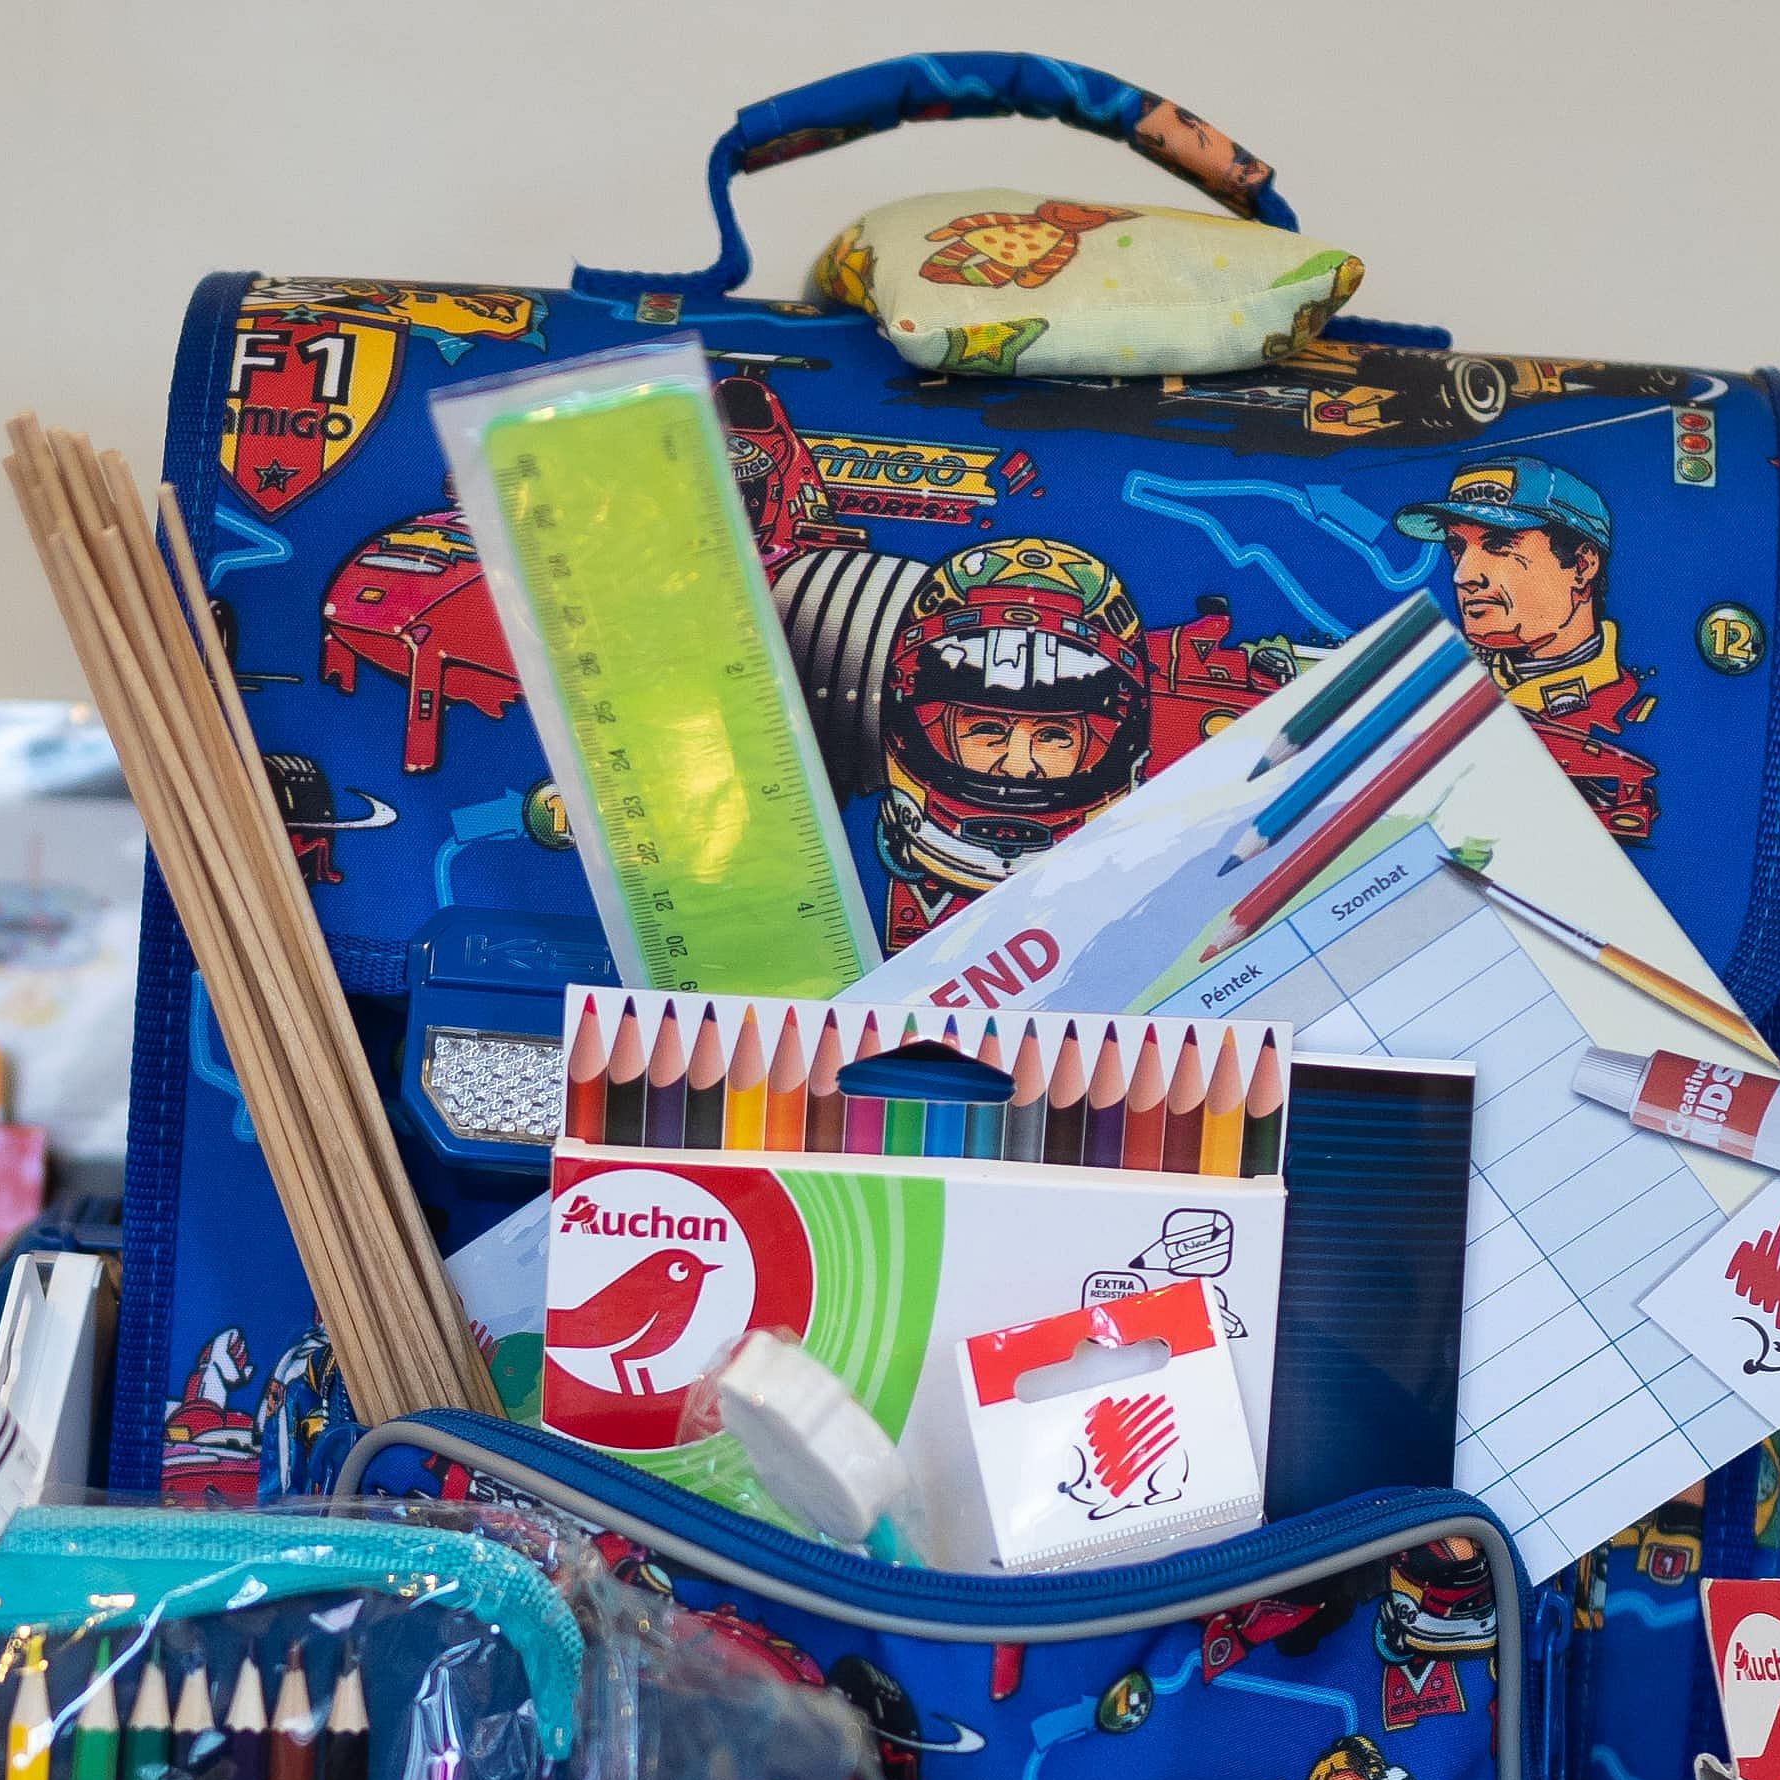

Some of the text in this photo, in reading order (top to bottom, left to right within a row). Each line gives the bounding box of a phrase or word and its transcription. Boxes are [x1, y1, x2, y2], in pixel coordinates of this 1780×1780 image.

[227, 328, 357, 405] F1
[562, 605, 586, 629] 27
[1709, 618, 1754, 663] 12
[578, 651, 602, 676] 26
[593, 700, 617, 724] 25
[610, 747, 632, 773] 24
[623, 795, 646, 819] 23
[636, 841, 660, 866] 22
[653, 888, 675, 912] 21
[1331, 863, 1411, 923] Szombat
[796, 901, 816, 917] 4
[666, 934, 689, 958] 20
[927, 926, 1062, 1009] END
[1200, 962, 1265, 1013] Péntek
[559, 1193, 728, 1243] Auchan
[1094, 1278, 1136, 1291] EXTRA
